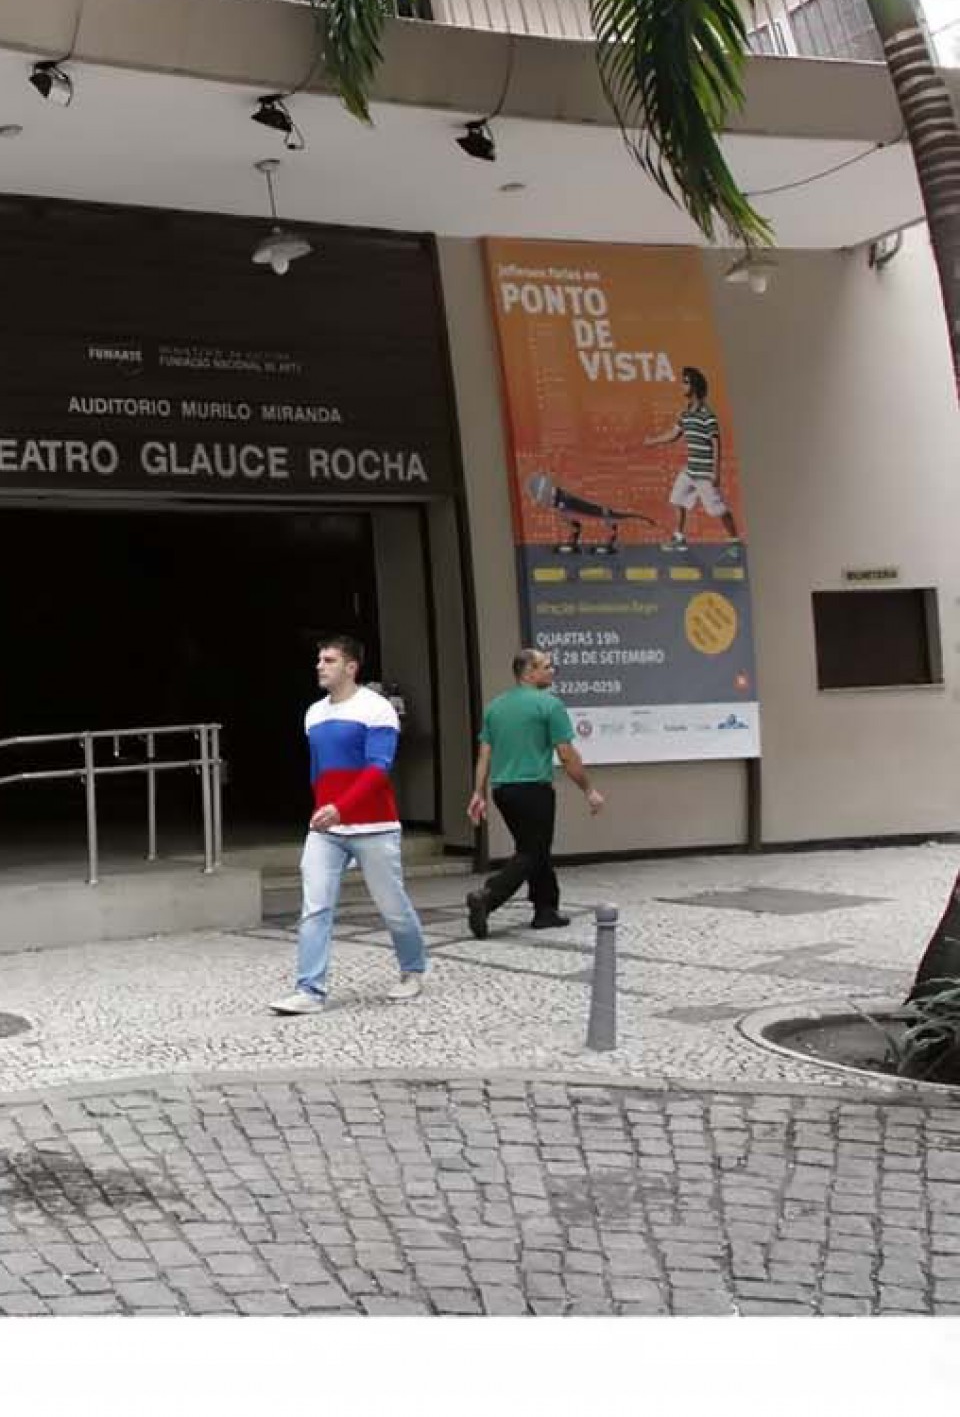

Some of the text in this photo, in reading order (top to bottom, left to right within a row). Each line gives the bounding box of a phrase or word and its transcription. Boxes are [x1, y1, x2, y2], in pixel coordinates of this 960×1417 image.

[501, 284, 608, 316] PONTO
[572, 319, 615, 350] DE
[578, 351, 677, 382] VISTA
[68, 396, 342, 424] AUDITORIO MURILO MIRANDA
[141, 441, 288, 479] GLAUCE
[308, 447, 428, 482] ROCHA
[536, 631, 620, 647] QUARTAS 19h
[562, 650, 579, 665] 28
[581, 650, 598, 665] DE
[600, 649, 666, 665] SETEMBRO
